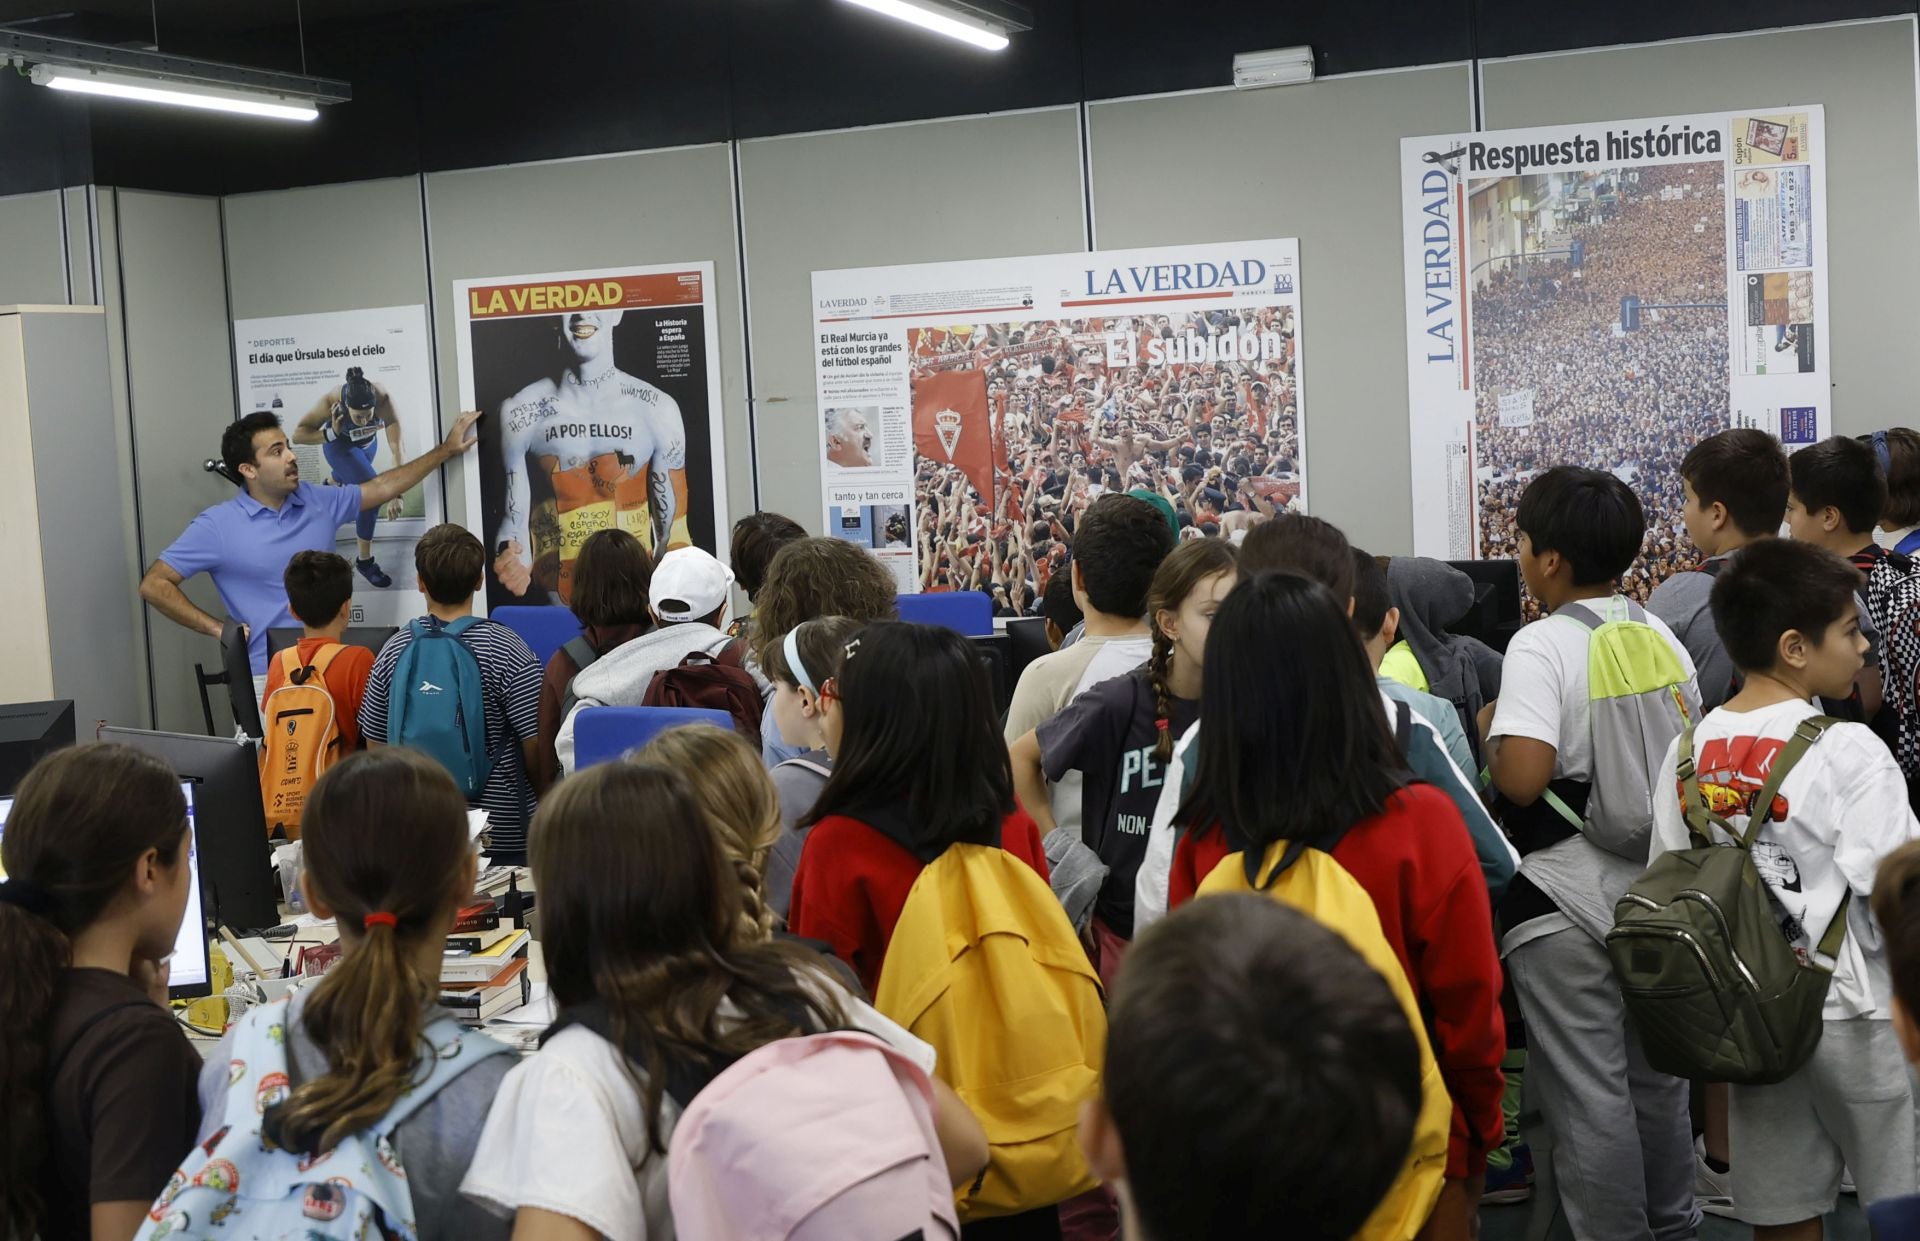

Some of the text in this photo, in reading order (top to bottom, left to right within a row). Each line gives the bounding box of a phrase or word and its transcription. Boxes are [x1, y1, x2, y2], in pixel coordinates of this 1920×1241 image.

[1469, 134, 1599, 175] Respuesta
[1606, 124, 1721, 161] histórica
[1422, 170, 1454, 364] LA VERDAD
[1085, 259, 1266, 296] LA VERDAD
[471, 290, 508, 315] LA
[509, 281, 623, 312] VERDAD
[820, 299, 831, 309] LA
[831, 297, 867, 308] VERDAD
[663, 319, 687, 327] Historia
[661, 327, 682, 335] espera
[821, 331, 888, 344] El Real Murcia ya
[253, 337, 296, 348] DEPORTES
[663, 334, 685, 342] España
[821, 343, 902, 356] está con los grandes
[1106, 325, 1282, 368] El subidón
[249, 344, 386, 364] El día que Úrsula besó el cielo
[822, 354, 892, 367] del fútbol español
[545, 424, 632, 442] ¡A POR ELLOS!
[834, 490, 904, 502] tanto y tan cerca
